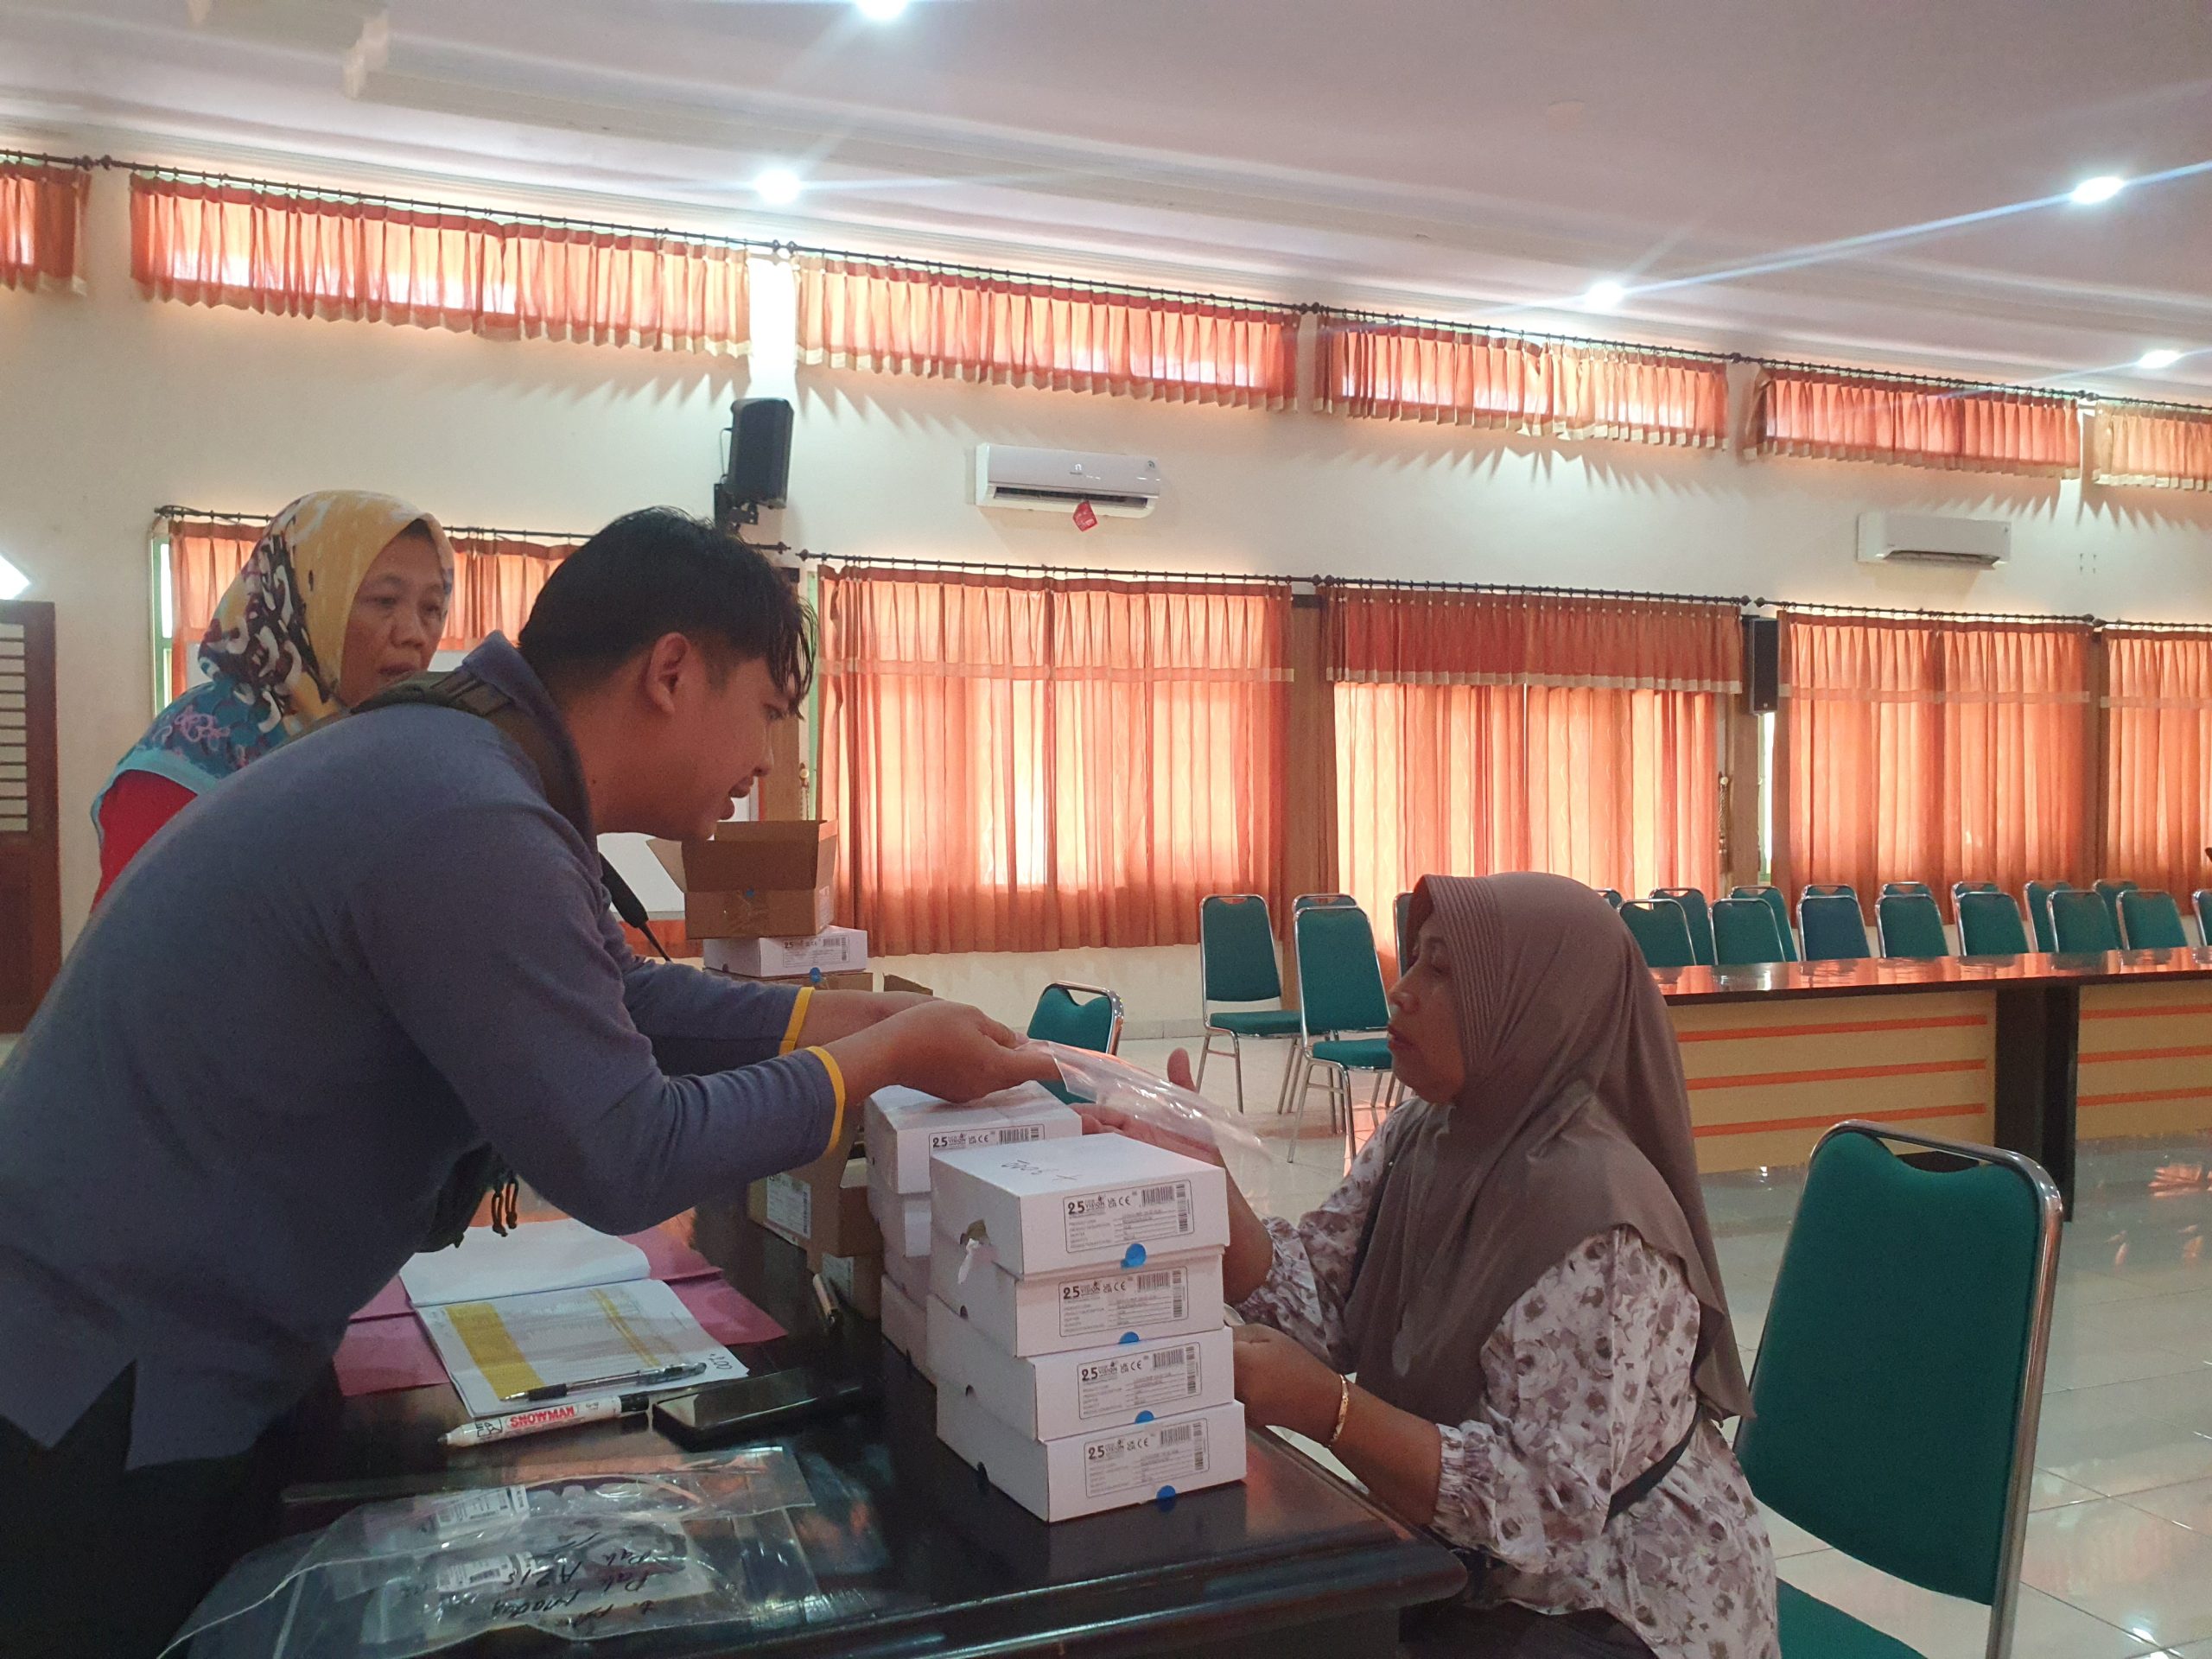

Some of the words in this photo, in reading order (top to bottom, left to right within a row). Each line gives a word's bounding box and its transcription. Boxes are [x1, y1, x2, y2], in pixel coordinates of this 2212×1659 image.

[932, 1136, 948, 1148] 25
[1067, 1200, 1085, 1215] 25
[1063, 1286, 1080, 1300] 25
[1081, 1367, 1098, 1382] 25
[509, 1405, 575, 1427] SNOWMAN
[1088, 1445, 1105, 1460] 25
